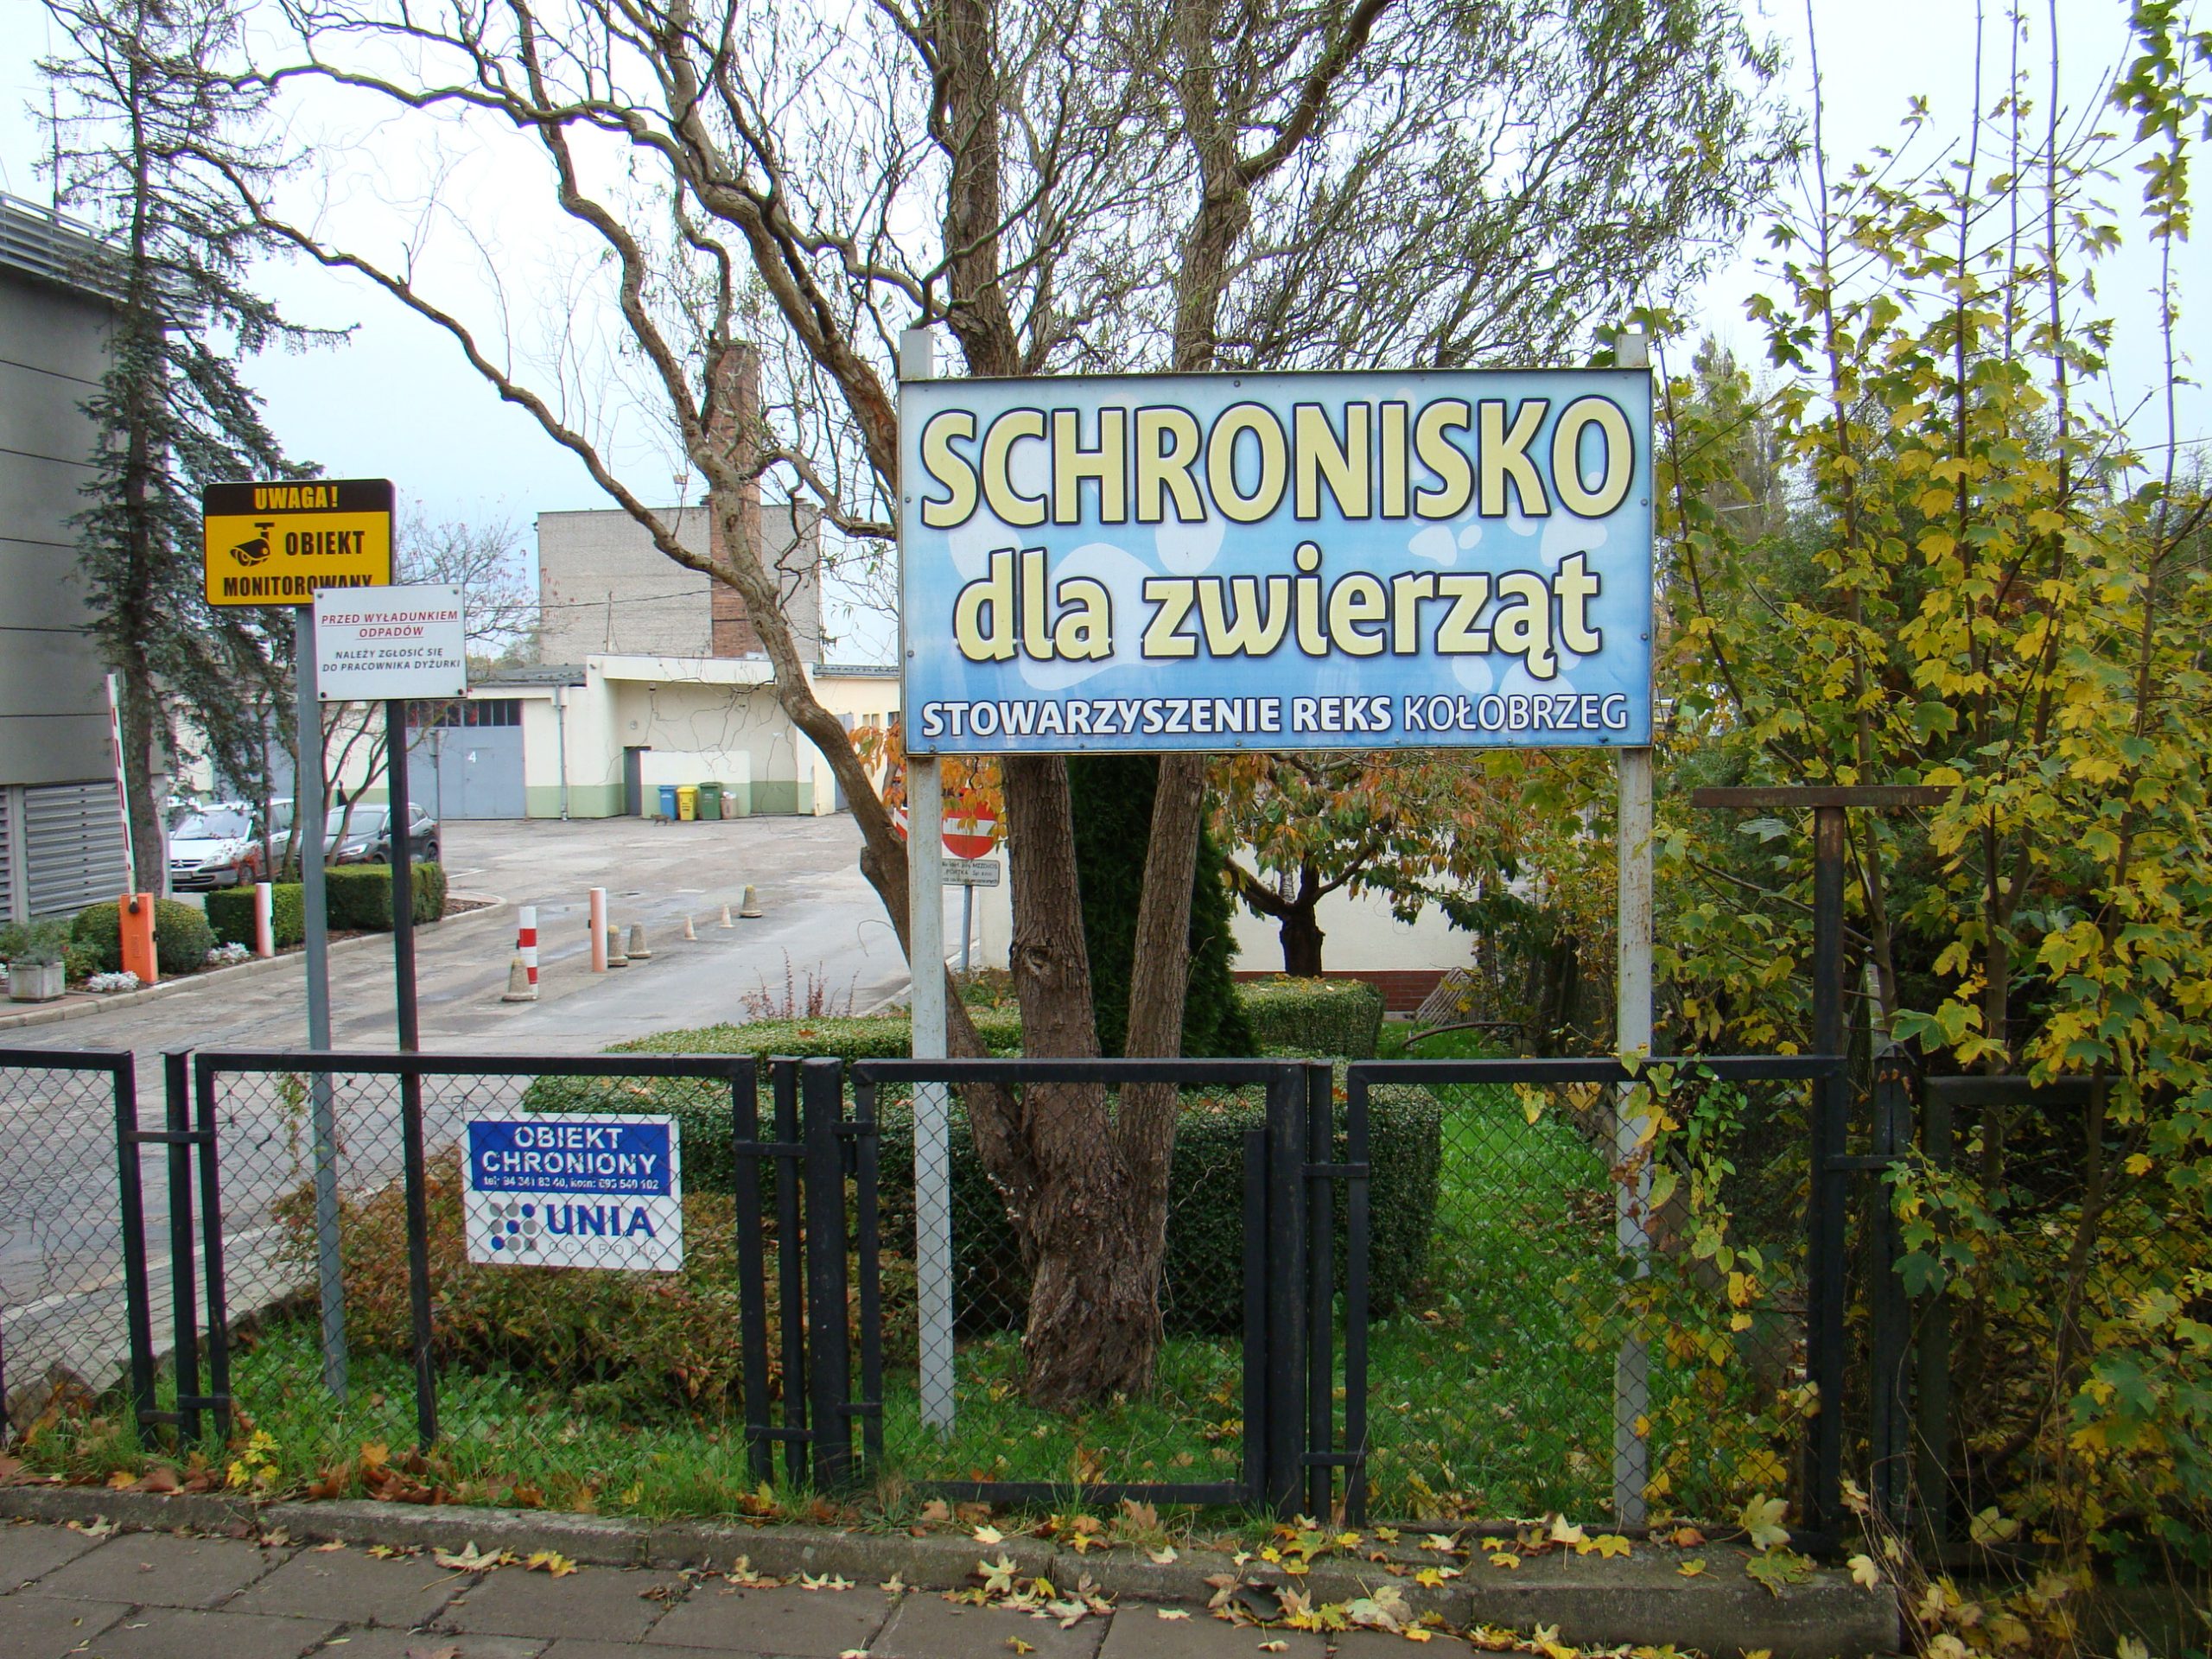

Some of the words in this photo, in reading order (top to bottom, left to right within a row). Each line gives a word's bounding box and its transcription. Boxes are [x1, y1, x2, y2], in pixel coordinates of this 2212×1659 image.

[920, 395, 1634, 529] SCHRONISKO
[254, 486, 338, 510] UWAGA!
[286, 531, 365, 556] OBIEKT
[321, 614, 360, 625] PRZED
[365, 610, 458, 623] WYŁADUNKIEM
[953, 547, 1114, 663] dla
[1142, 541, 1601, 680] zwierząt
[359, 626, 424, 638] ODPADÓW
[335, 650, 376, 659] NALEŻY
[378, 647, 424, 658] ZGŁOSIĆ
[427, 648, 443, 658] SIĘ
[322, 664, 338, 672] DO
[341, 661, 410, 671] PRACOWNIKA
[922, 697, 1281, 737] STOWARZYSZENIE
[1292, 696, 1392, 733] REKS
[1403, 693, 1626, 733] KOŁOBRZEG
[467, 751, 477, 763] 4
[514, 1127, 623, 1149] OBIEKT
[482, 1151, 657, 1175] CHRONIONY
[546, 1205, 656, 1237] UNIA
